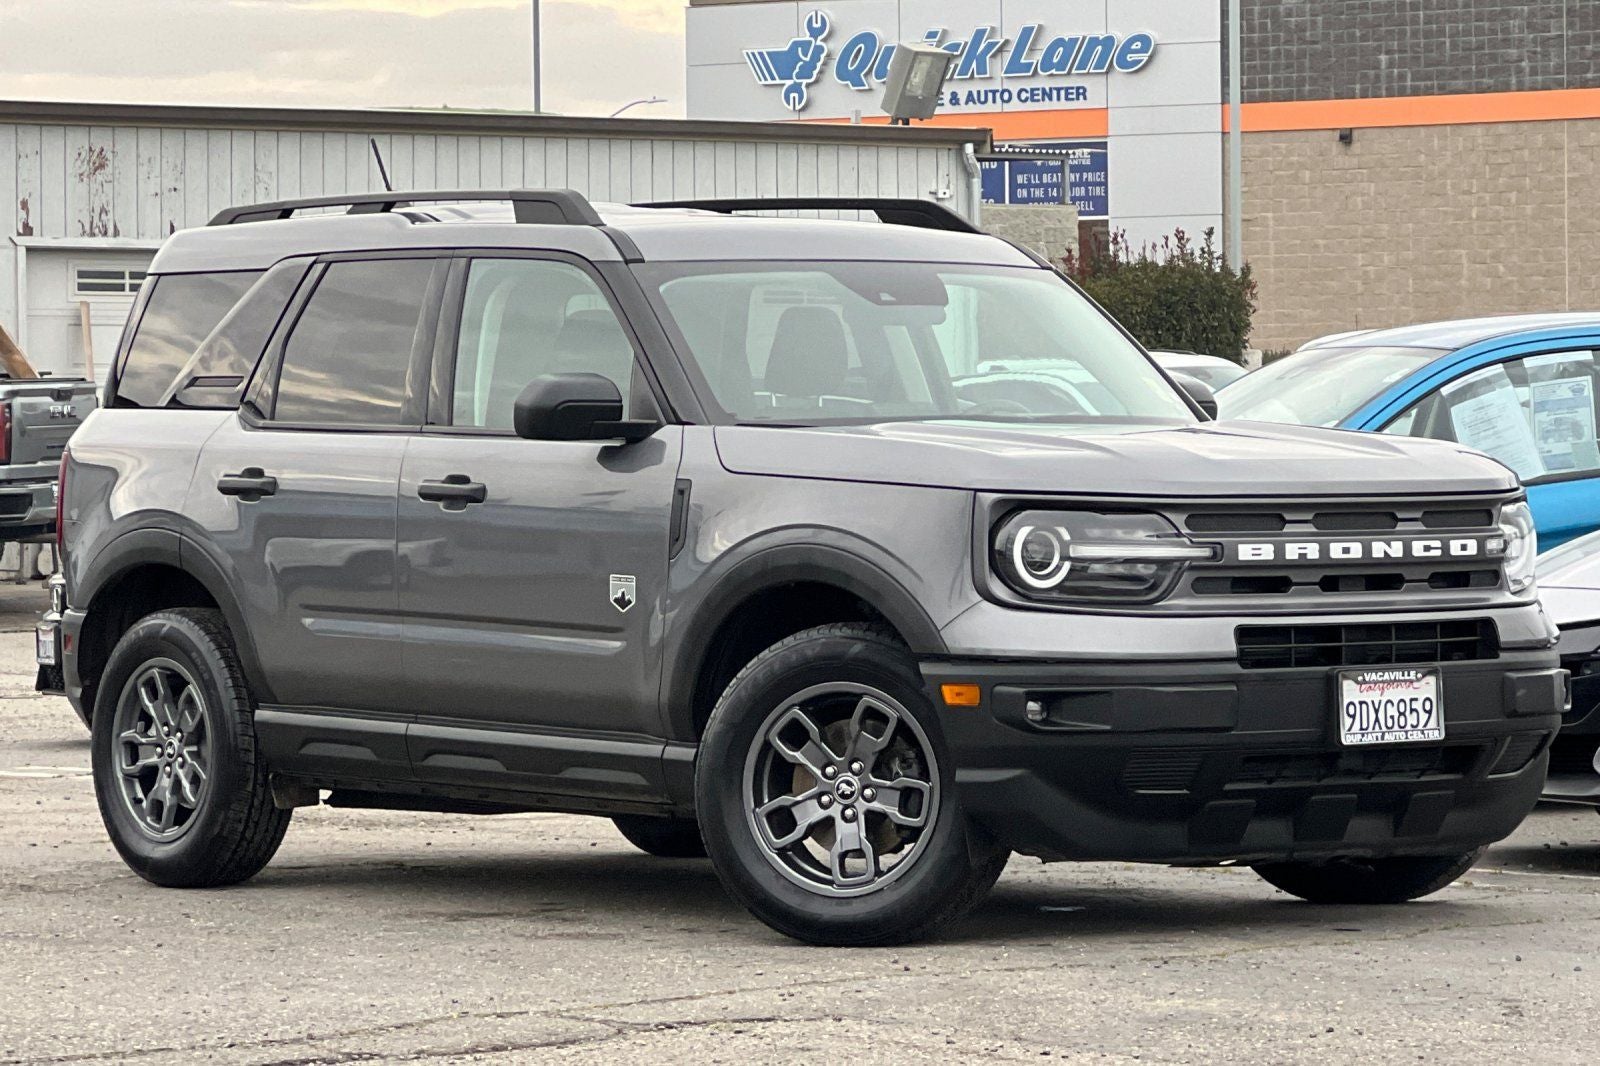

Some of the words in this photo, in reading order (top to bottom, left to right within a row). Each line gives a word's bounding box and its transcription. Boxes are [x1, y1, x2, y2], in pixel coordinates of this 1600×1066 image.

[1001, 24, 1155, 77] Lane
[949, 91, 961, 106] &
[965, 88, 1013, 105] AUTO
[1017, 85, 1088, 103] CENTER
[1017, 173, 1040, 184] WE'LL
[1042, 172, 1062, 183] BEAT
[1082, 171, 1105, 182] PRICE
[1016, 188, 1028, 198] ON
[1030, 187, 1045, 198] THE
[1047, 187, 1058, 197] 14
[1060, 186, 1086, 197] JOR
[1088, 186, 1106, 197] TIRE
[1075, 201, 1095, 211] SELL
[1237, 538, 1478, 561] BRONCO
[1363, 670, 1417, 681] VACAVILLE
[1345, 696, 1434, 732] 9DXG859
[1383, 731, 1406, 741] AUTO
